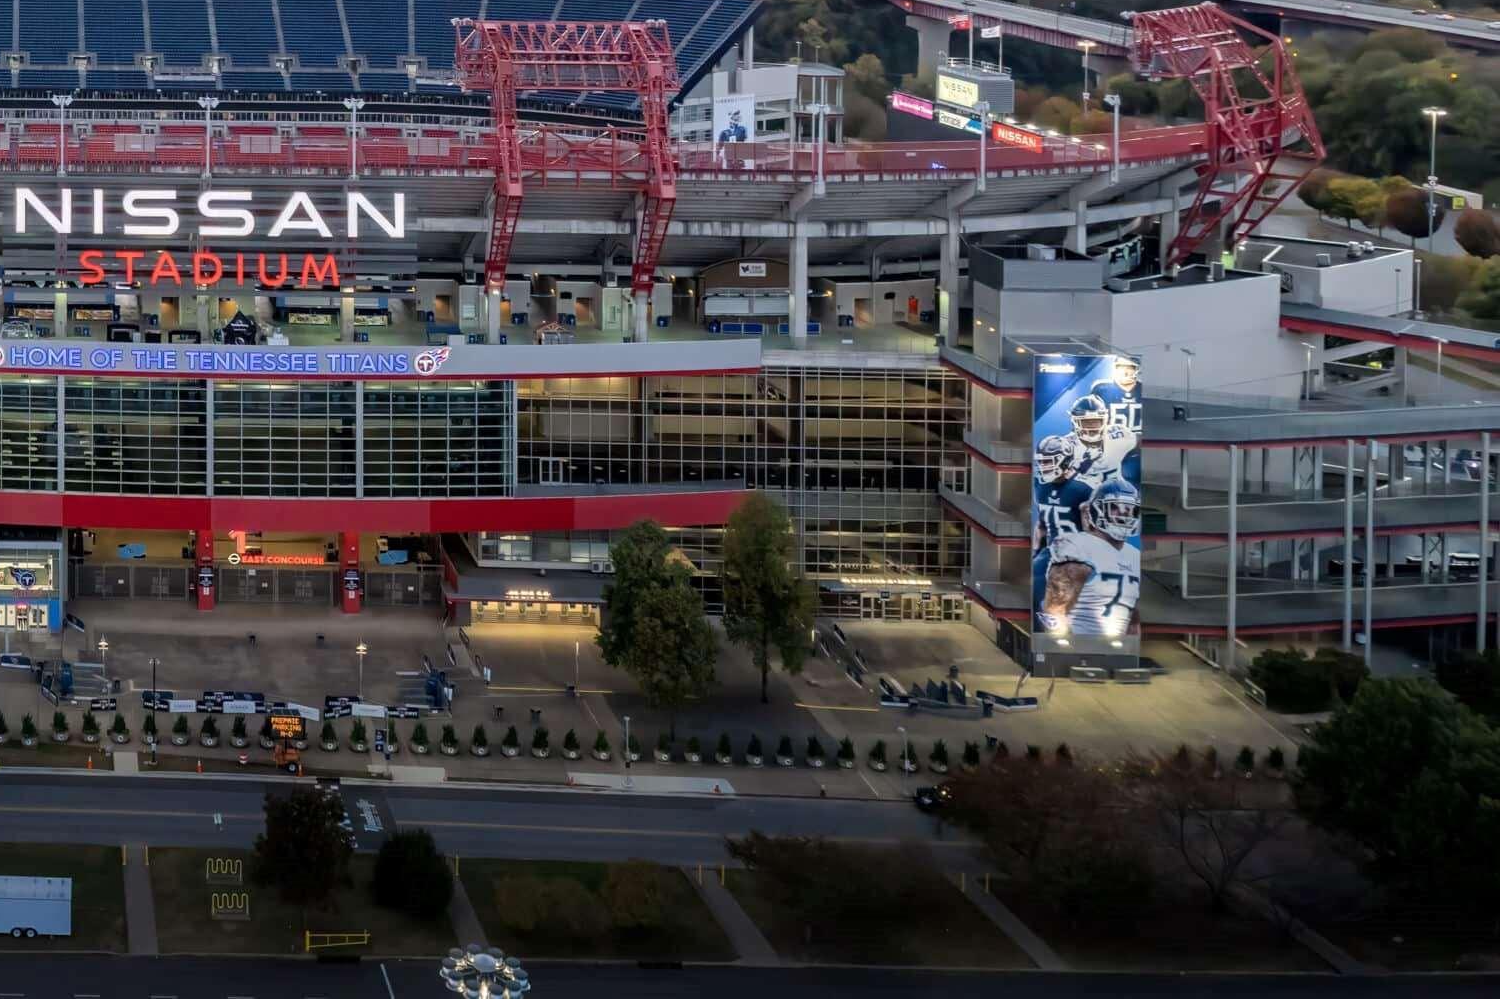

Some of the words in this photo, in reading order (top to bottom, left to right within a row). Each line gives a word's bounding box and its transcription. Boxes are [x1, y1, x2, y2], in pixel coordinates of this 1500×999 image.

[997, 129, 1037, 147] NISSAN
[15, 188, 405, 238] NISSAN
[78, 250, 340, 287] STADIUM
[10, 346, 82, 367] HOME
[90, 347, 124, 368] OF
[131, 349, 176, 370] THE
[186, 351, 317, 372] TENNESSEE
[326, 353, 408, 373] TITANS
[228, 530, 246, 553] 1
[241, 555, 265, 563] EAST
[267, 555, 325, 565] CONCOURSE
